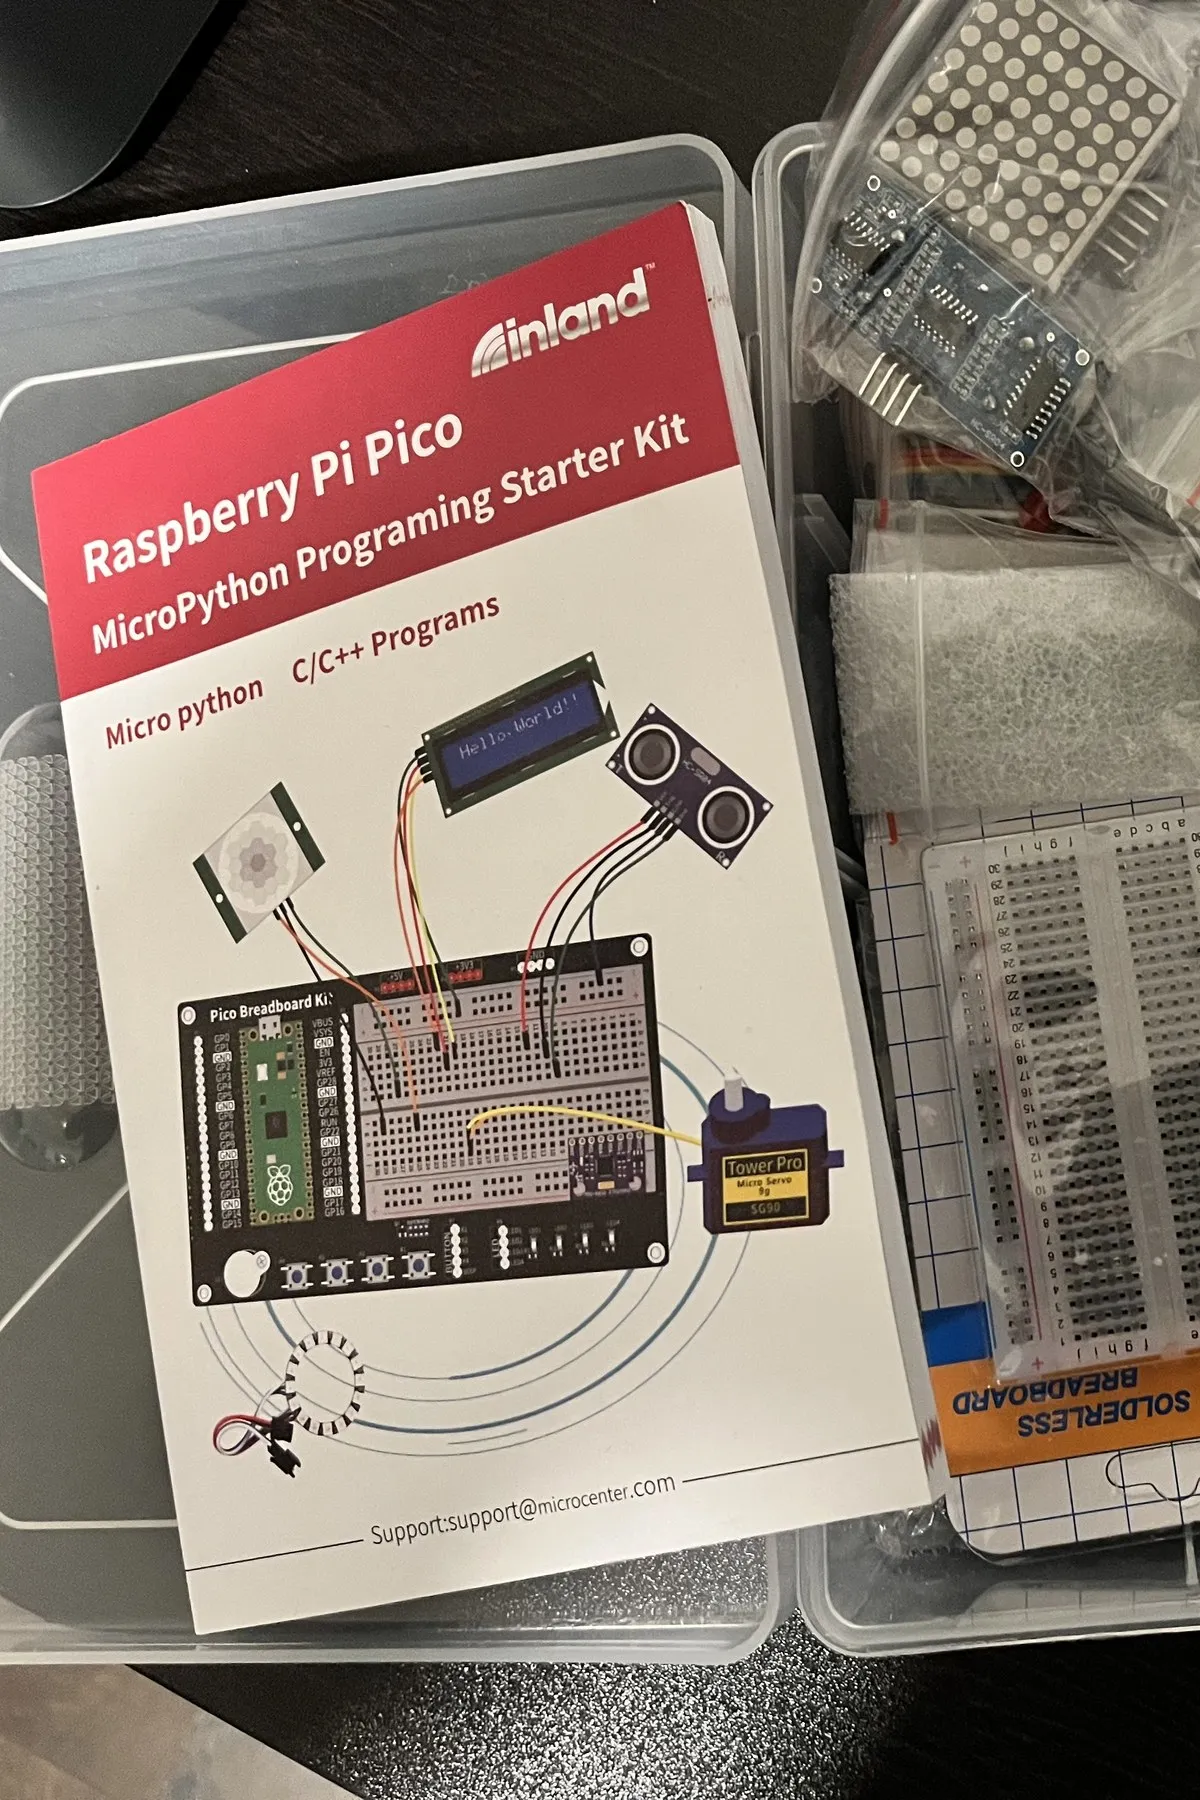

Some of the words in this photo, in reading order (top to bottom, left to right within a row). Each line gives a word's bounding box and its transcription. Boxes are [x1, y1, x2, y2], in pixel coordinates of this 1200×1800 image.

[508, 267, 650, 362] inland
[82, 472, 301, 583] Raspberry
[311, 440, 355, 496] Pi
[365, 414, 463, 477] Pico
[92, 562, 290, 655] MicroPython
[295, 486, 494, 582] Programing
[500, 436, 625, 505] Starter
[633, 413, 690, 459] Kit
[105, 707, 171, 750] Micro
[179, 676, 264, 732] python
[292, 641, 365, 686] C/C++
[371, 596, 500, 658] Programs
[716, 851, 725, 861] R
[456, 961, 474, 971] +3V3
[210, 1006, 237, 1022] Pico
[240, 995, 312, 1017] Breadboard
[312, 1018, 333, 1028] VBUS
[313, 1028, 333, 1037] VSYS
[214, 1033, 230, 1043] GP0
[314, 1037, 334, 1048] GND
[214, 1043, 230, 1053] GP1
[319, 1049, 331, 1057] EN
[213, 1053, 231, 1062] GND
[318, 1058, 333, 1067] 3V3
[316, 1067, 336, 1077] VREF
[216, 1073, 231, 1082] GP3
[217, 1082, 232, 1092] GP4
[318, 1086, 336, 1097] GND
[216, 1101, 234, 1111] GND
[319, 1107, 339, 1117] GP26
[219, 1121, 234, 1131] GP7
[320, 1117, 338, 1127] RUN
[320, 1127, 340, 1137] GP22
[321, 1136, 340, 1147] GND
[219, 1150, 237, 1160] GND
[321, 1147, 341, 1157] GP21
[218, 1161, 239, 1170] GP10
[322, 1157, 342, 1167] GP20
[728, 1159, 774, 1175] Tower
[777, 1156, 802, 1171] Pro
[219, 1170, 239, 1180] GP11
[220, 1179, 239, 1190] GP12
[737, 1179, 763, 1187] Micro
[766, 1176, 792, 1185] Servo
[221, 1189, 240, 1199] GP13
[323, 1186, 343, 1197] GND
[222, 1199, 240, 1209] GND
[324, 1197, 343, 1207] GP17
[325, 1206, 345, 1217] GP16
[751, 1202, 781, 1215] SG90
[222, 1210, 241, 1220] GP14
[222, 1218, 242, 1229] GP15
[1190, 1329, 1199, 1340] e
[1108, 1343, 1117, 1356] h
[1124, 1339, 1133, 1352] g
[953, 1367, 1138, 1415] BREADBOARD
[1018, 1390, 1190, 1437] SOLDERLESS
[371, 1476, 676, 1547] Support:support@microcenter.com
